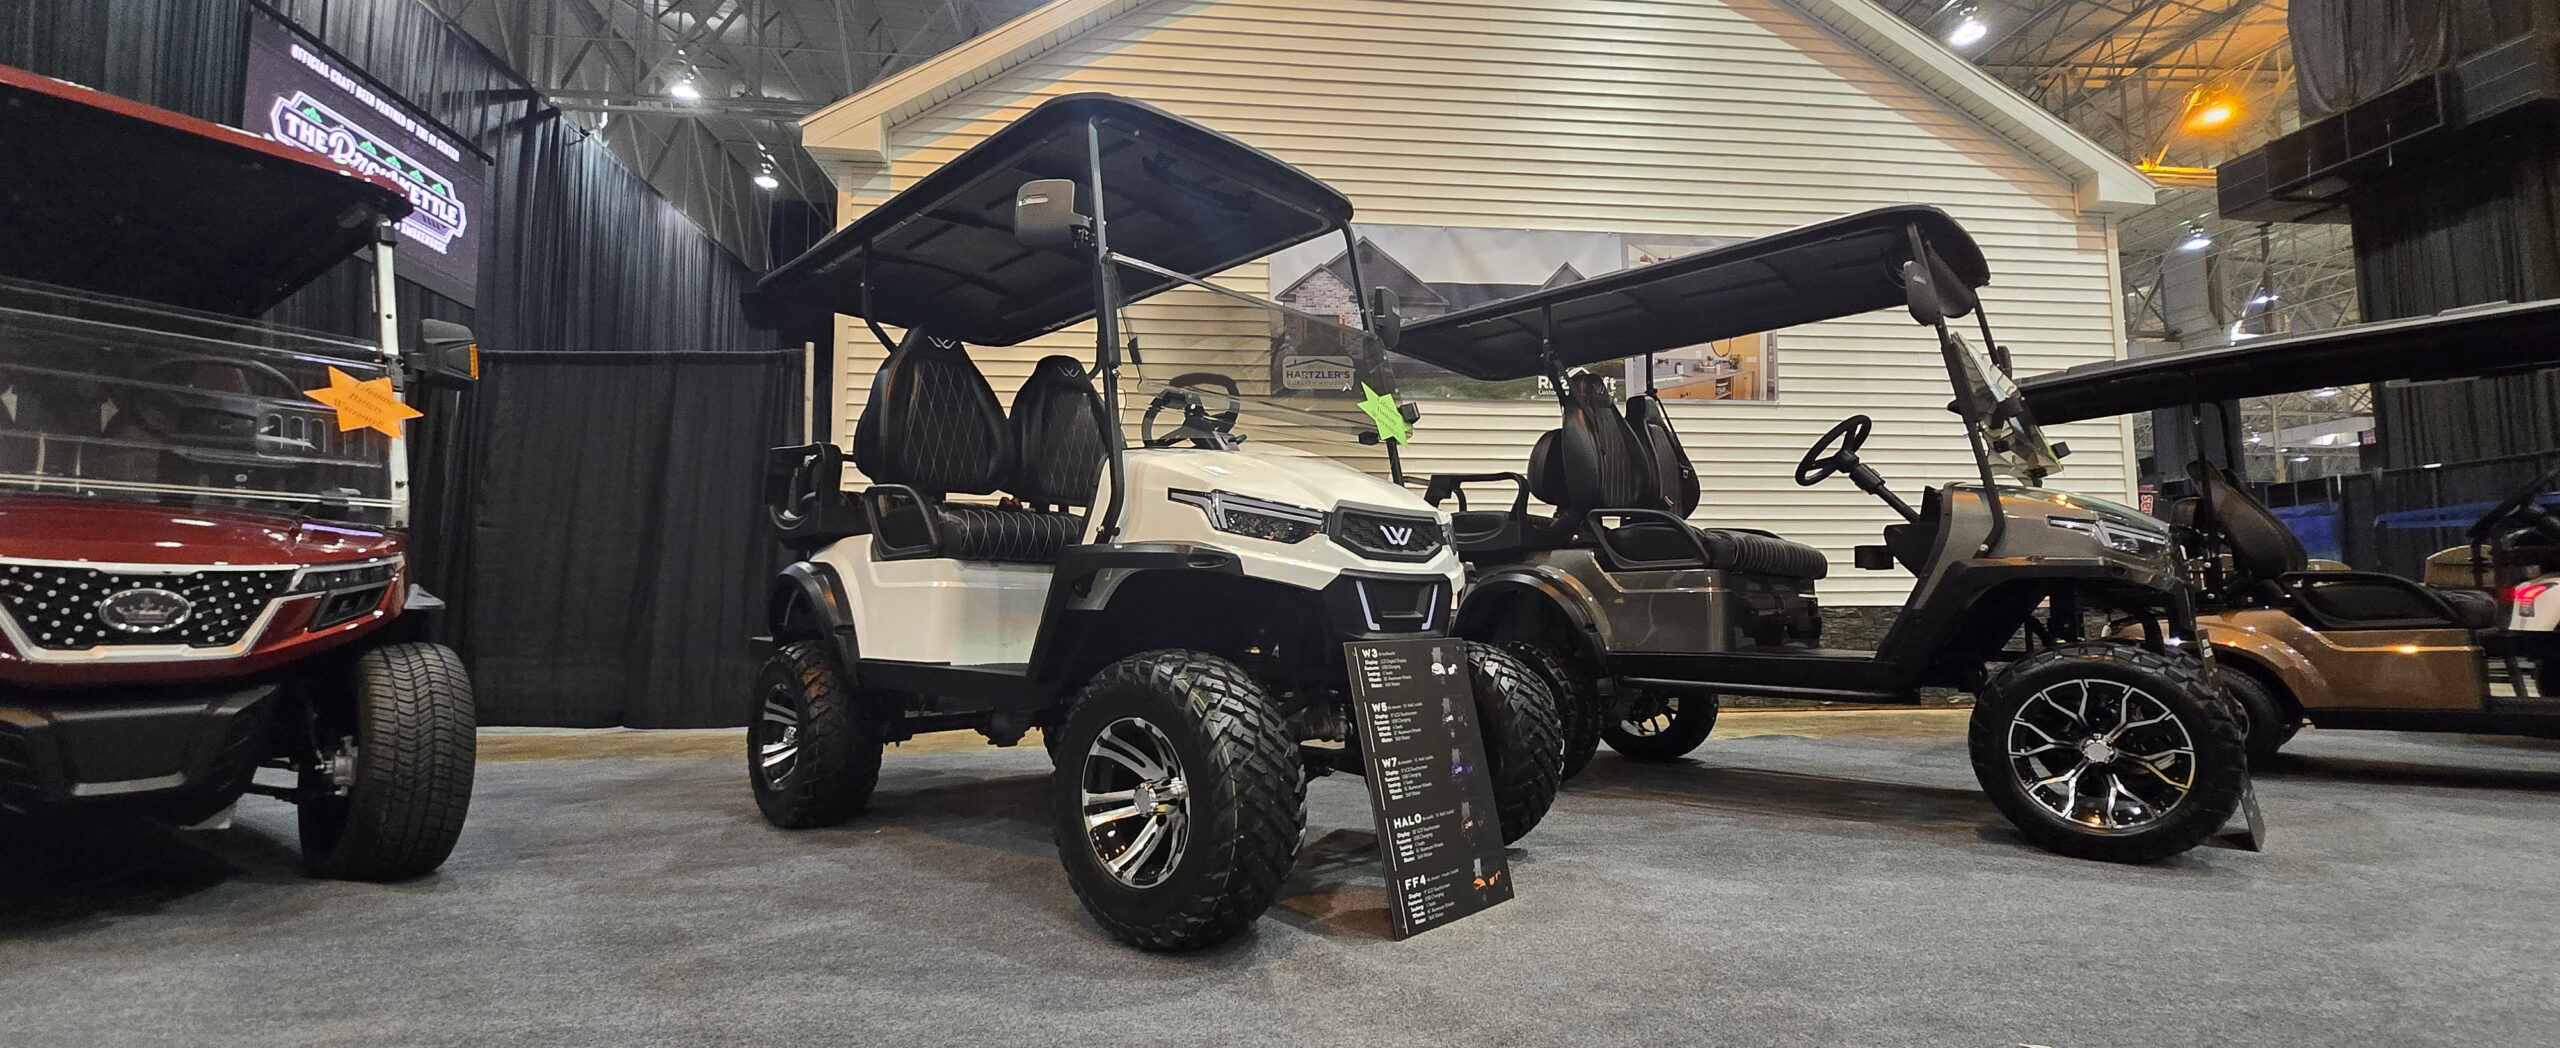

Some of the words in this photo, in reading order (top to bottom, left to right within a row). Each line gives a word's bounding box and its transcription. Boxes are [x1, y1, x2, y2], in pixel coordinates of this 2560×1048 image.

[290, 43, 330, 78] OFFICIAL
[330, 68, 357, 94] CRAFT
[356, 86, 375, 107] BEER
[375, 98, 406, 128] PARTNER
[285, 112, 329, 154] THE
[1286, 371, 1350, 379] HARTZLER'S
[355, 382, 395, 406] Lifetime
[349, 393, 385, 414] Battery
[1361, 648, 1378, 658] W3
[1371, 702, 1387, 712] W5
[1381, 757, 1397, 768] W7
[1393, 813, 1422, 829] HALO
